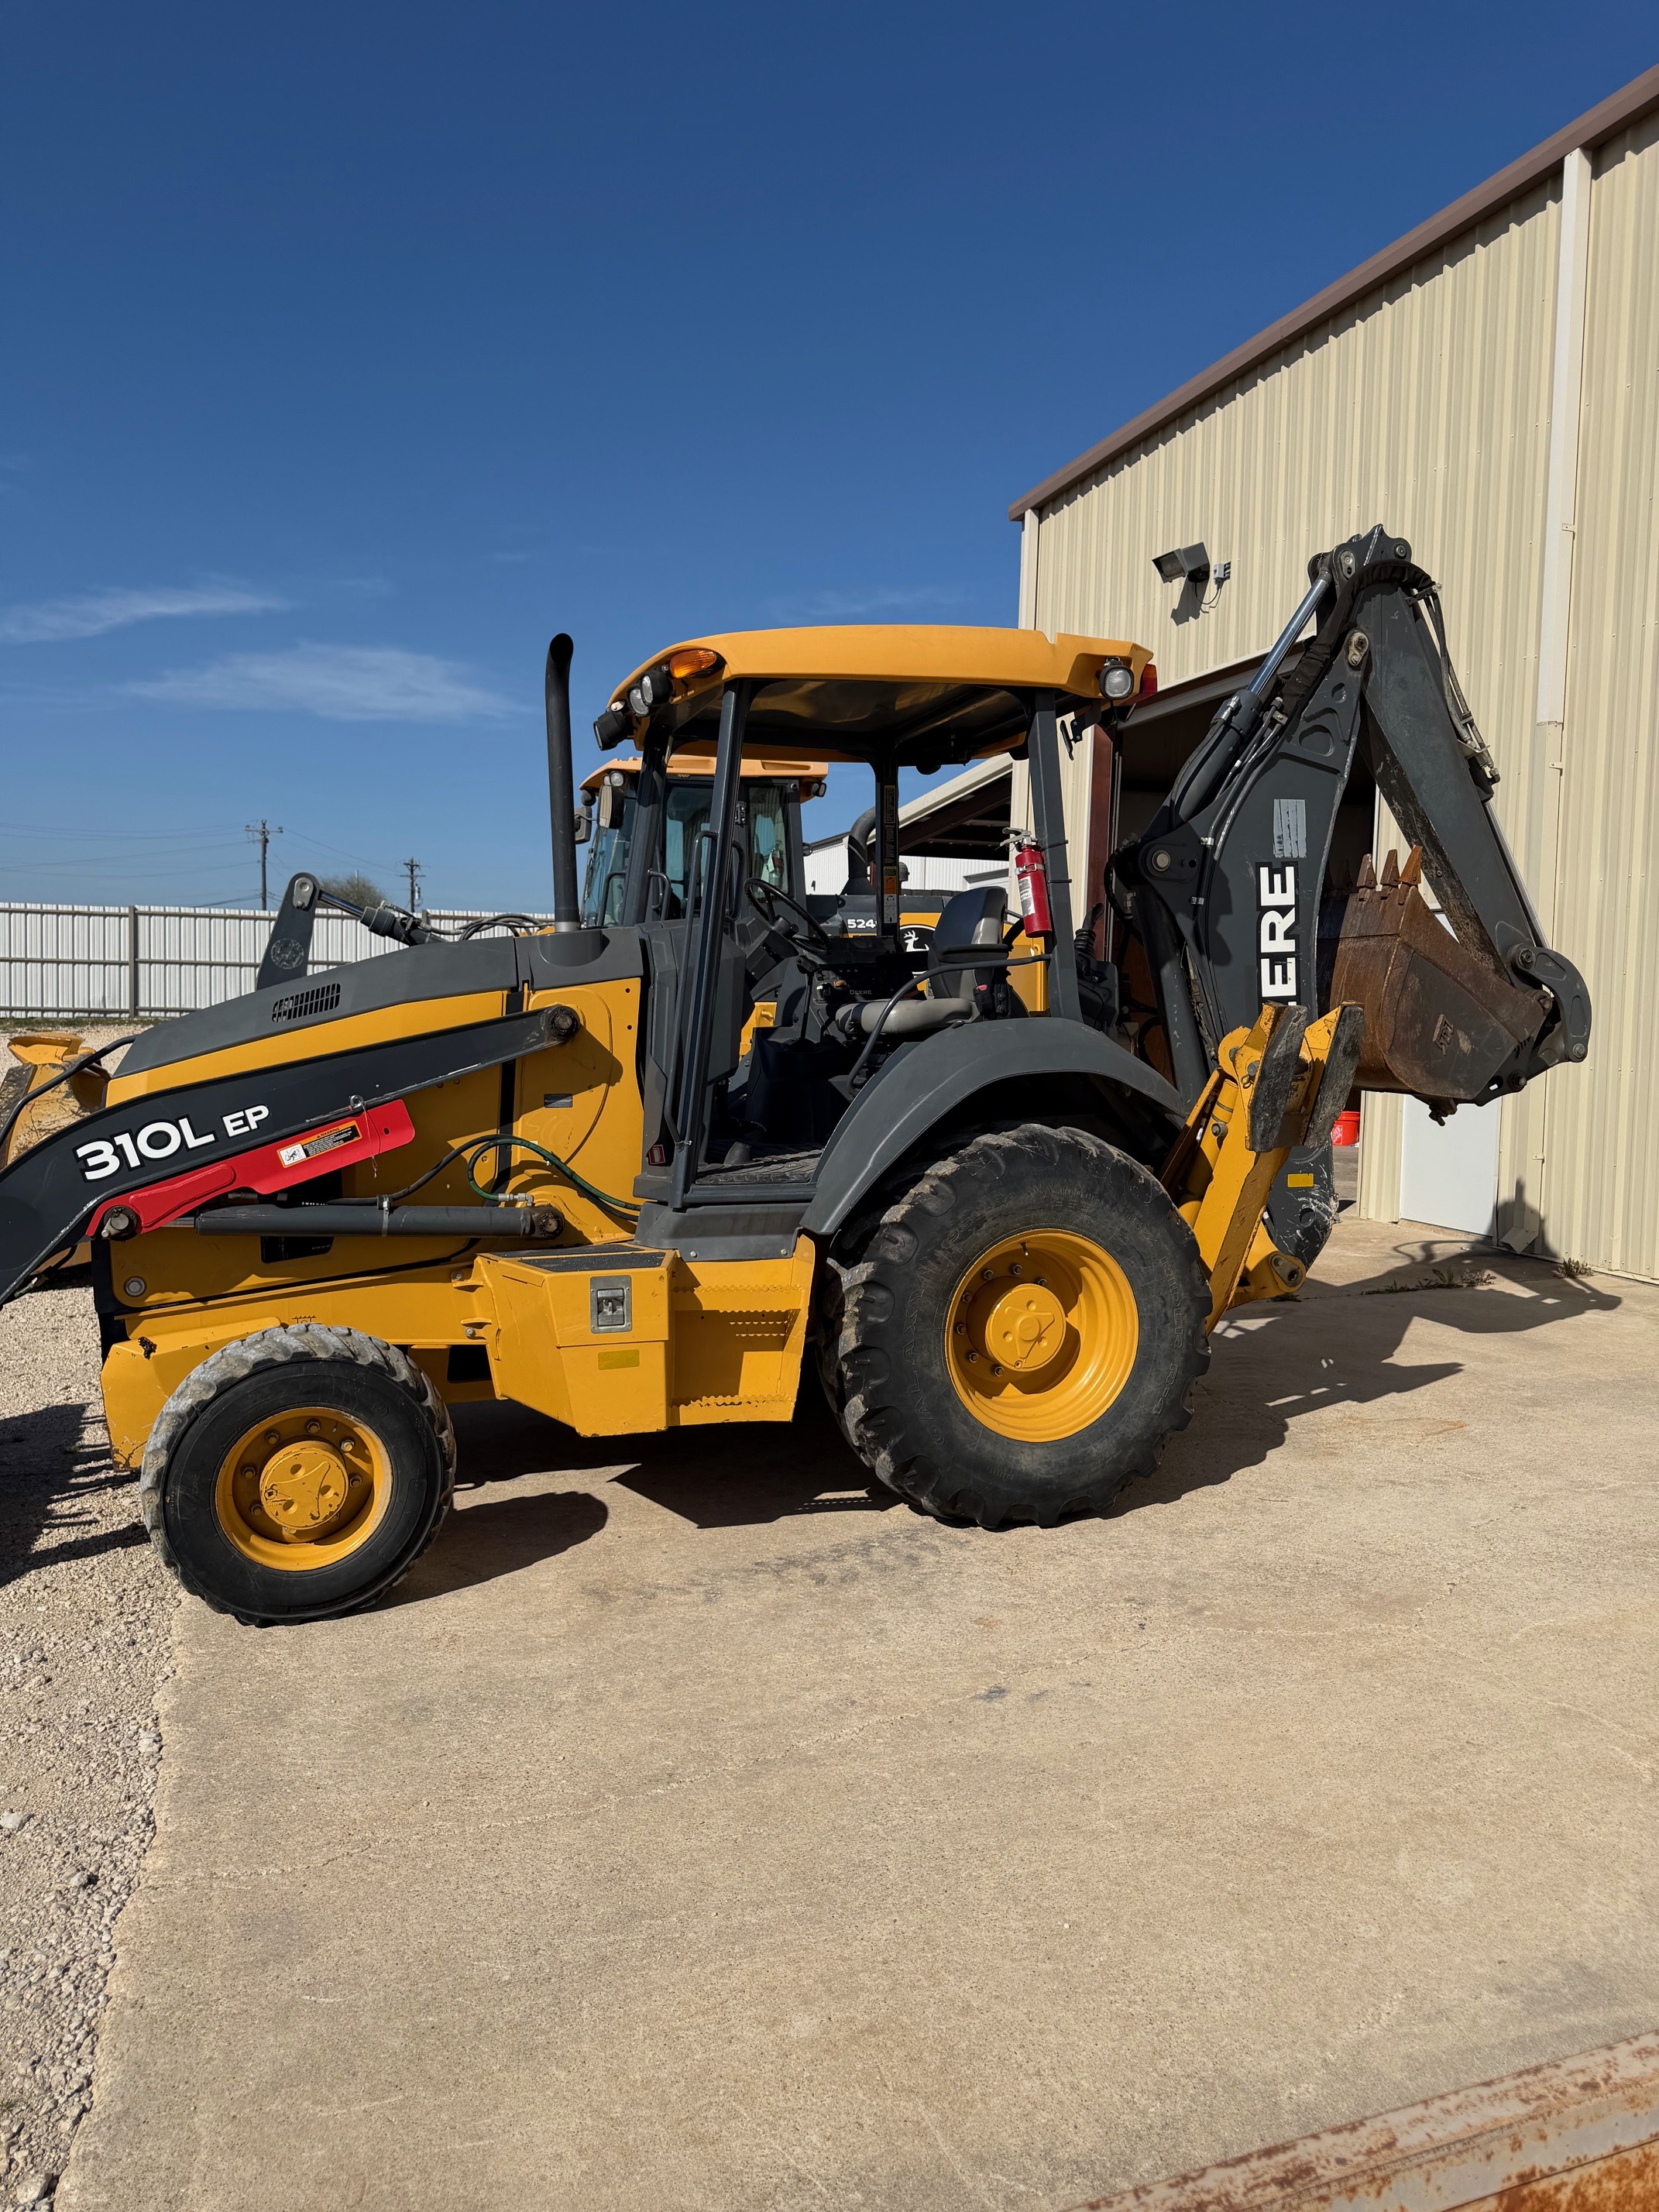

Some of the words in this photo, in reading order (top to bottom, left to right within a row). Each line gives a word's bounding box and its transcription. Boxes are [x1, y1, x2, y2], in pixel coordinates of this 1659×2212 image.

[847, 919, 878, 929] 524
[1259, 866, 1297, 1006] ERE
[76, 1118, 215, 1180] 310L
[222, 1104, 270, 1137] EP
[1159, 1255, 1184, 1349] RIDER
[902, 1288, 946, 1447] GALAXY
